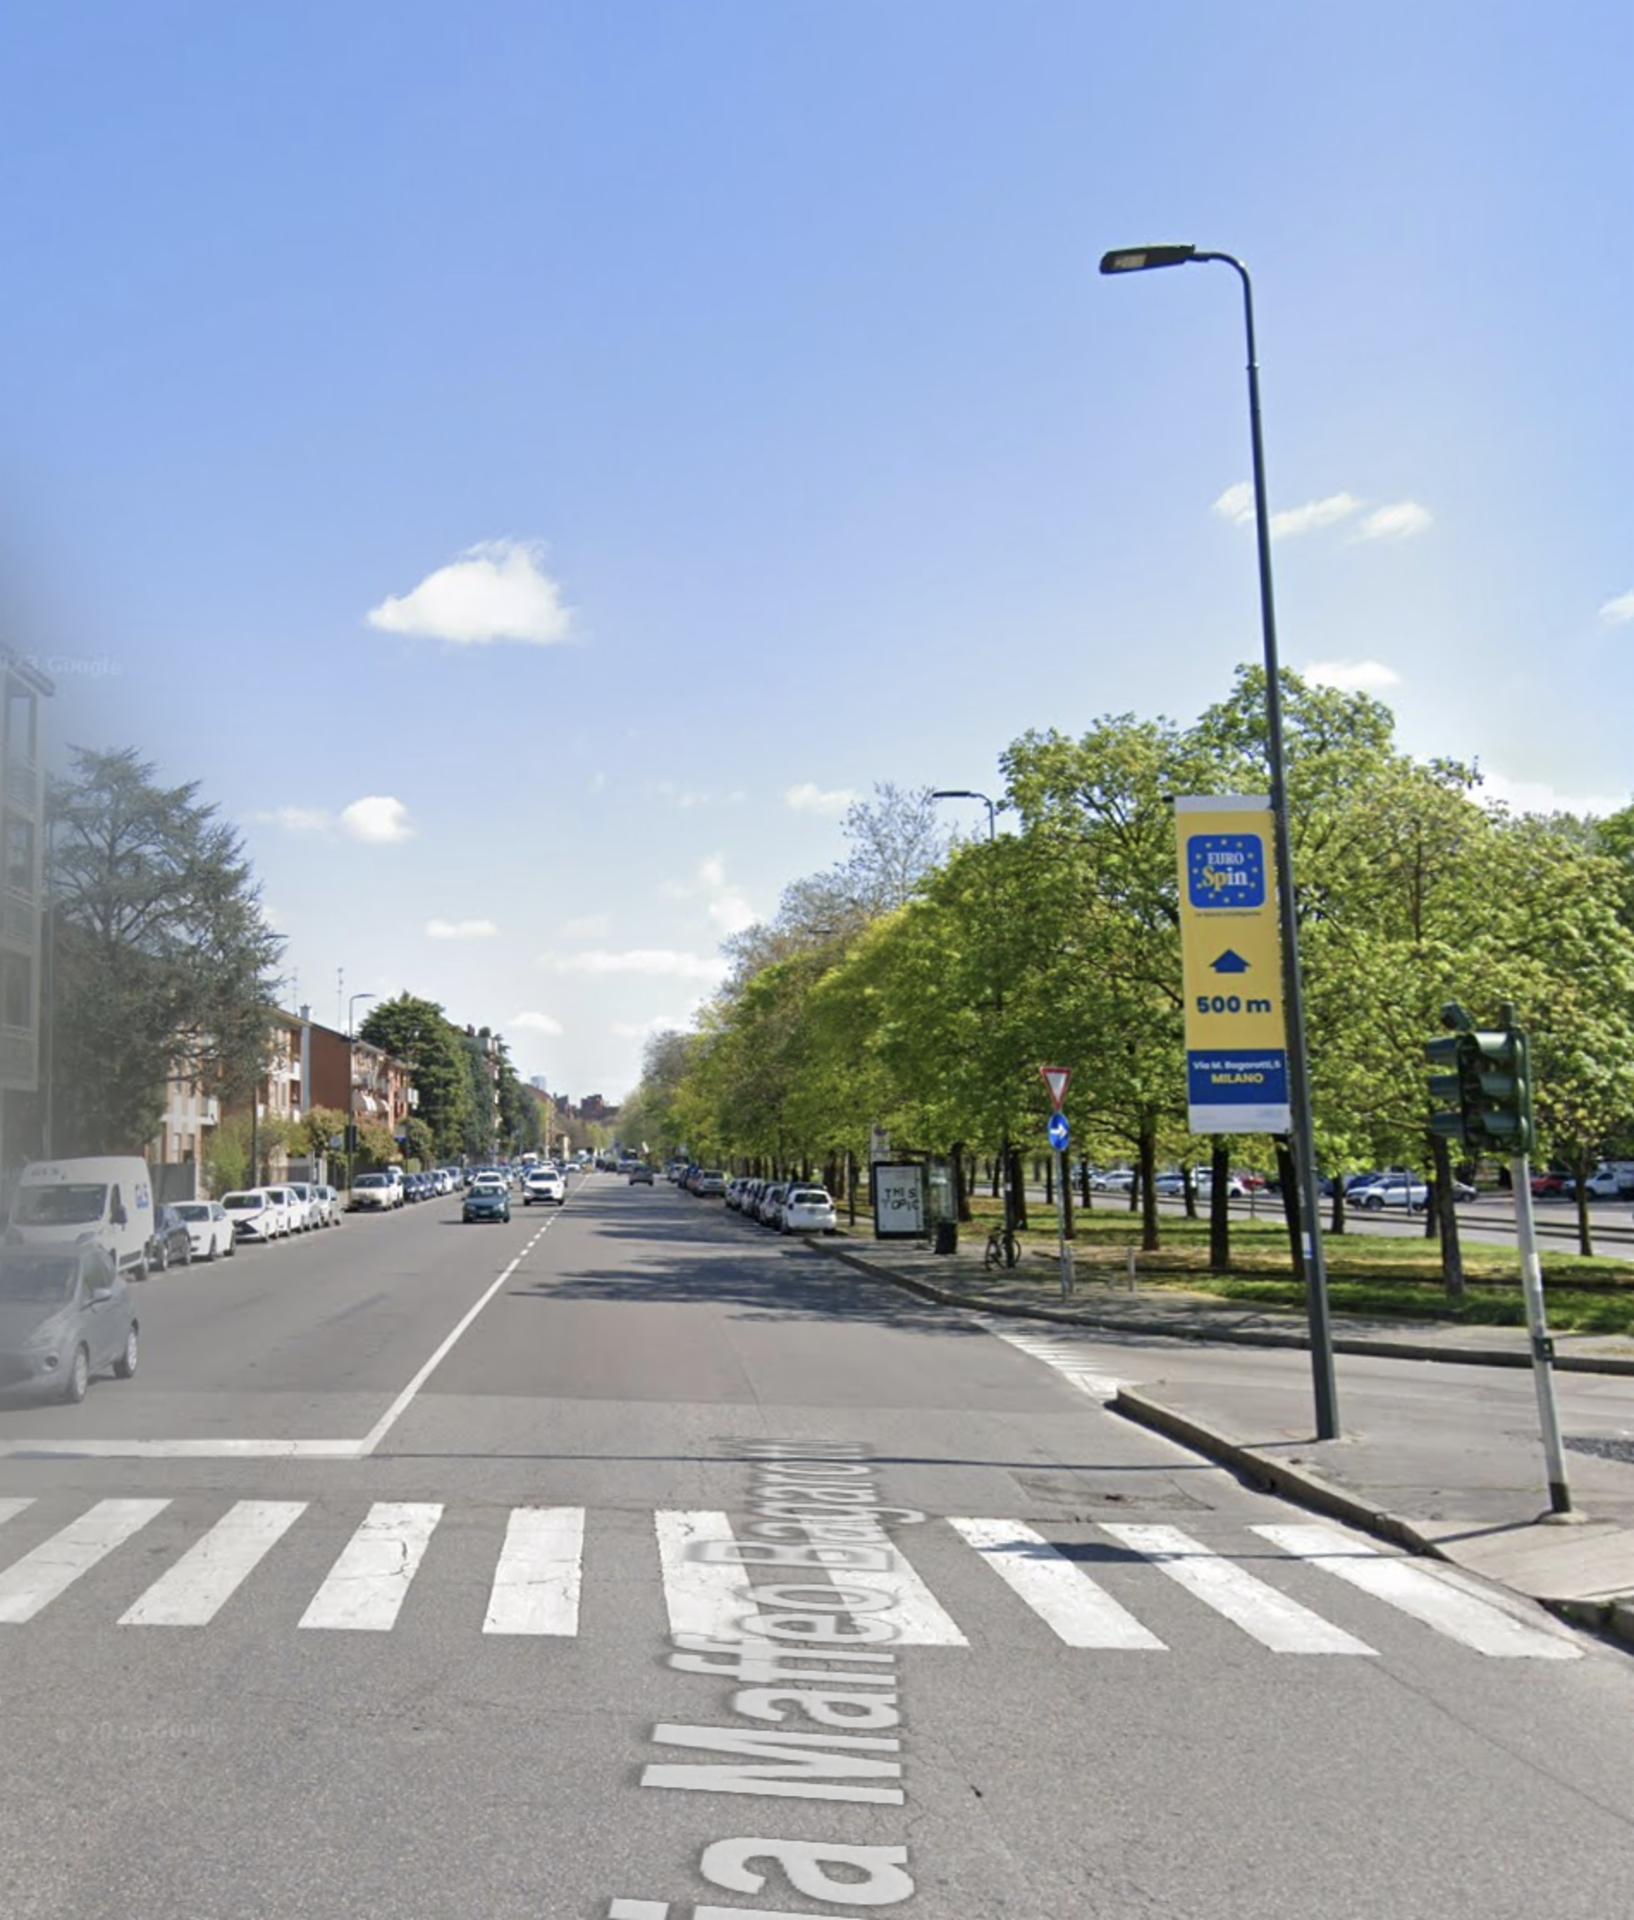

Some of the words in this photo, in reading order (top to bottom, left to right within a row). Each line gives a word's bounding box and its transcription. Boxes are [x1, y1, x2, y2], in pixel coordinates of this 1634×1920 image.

[1207, 852, 1245, 865] EURO
[1202, 866, 1249, 892] Spin
[1196, 995, 1241, 1013] 500
[1246, 998, 1272, 1013] m
[1192, 1061, 1210, 1070] Via
[1210, 1073, 1265, 1084] MILANO
